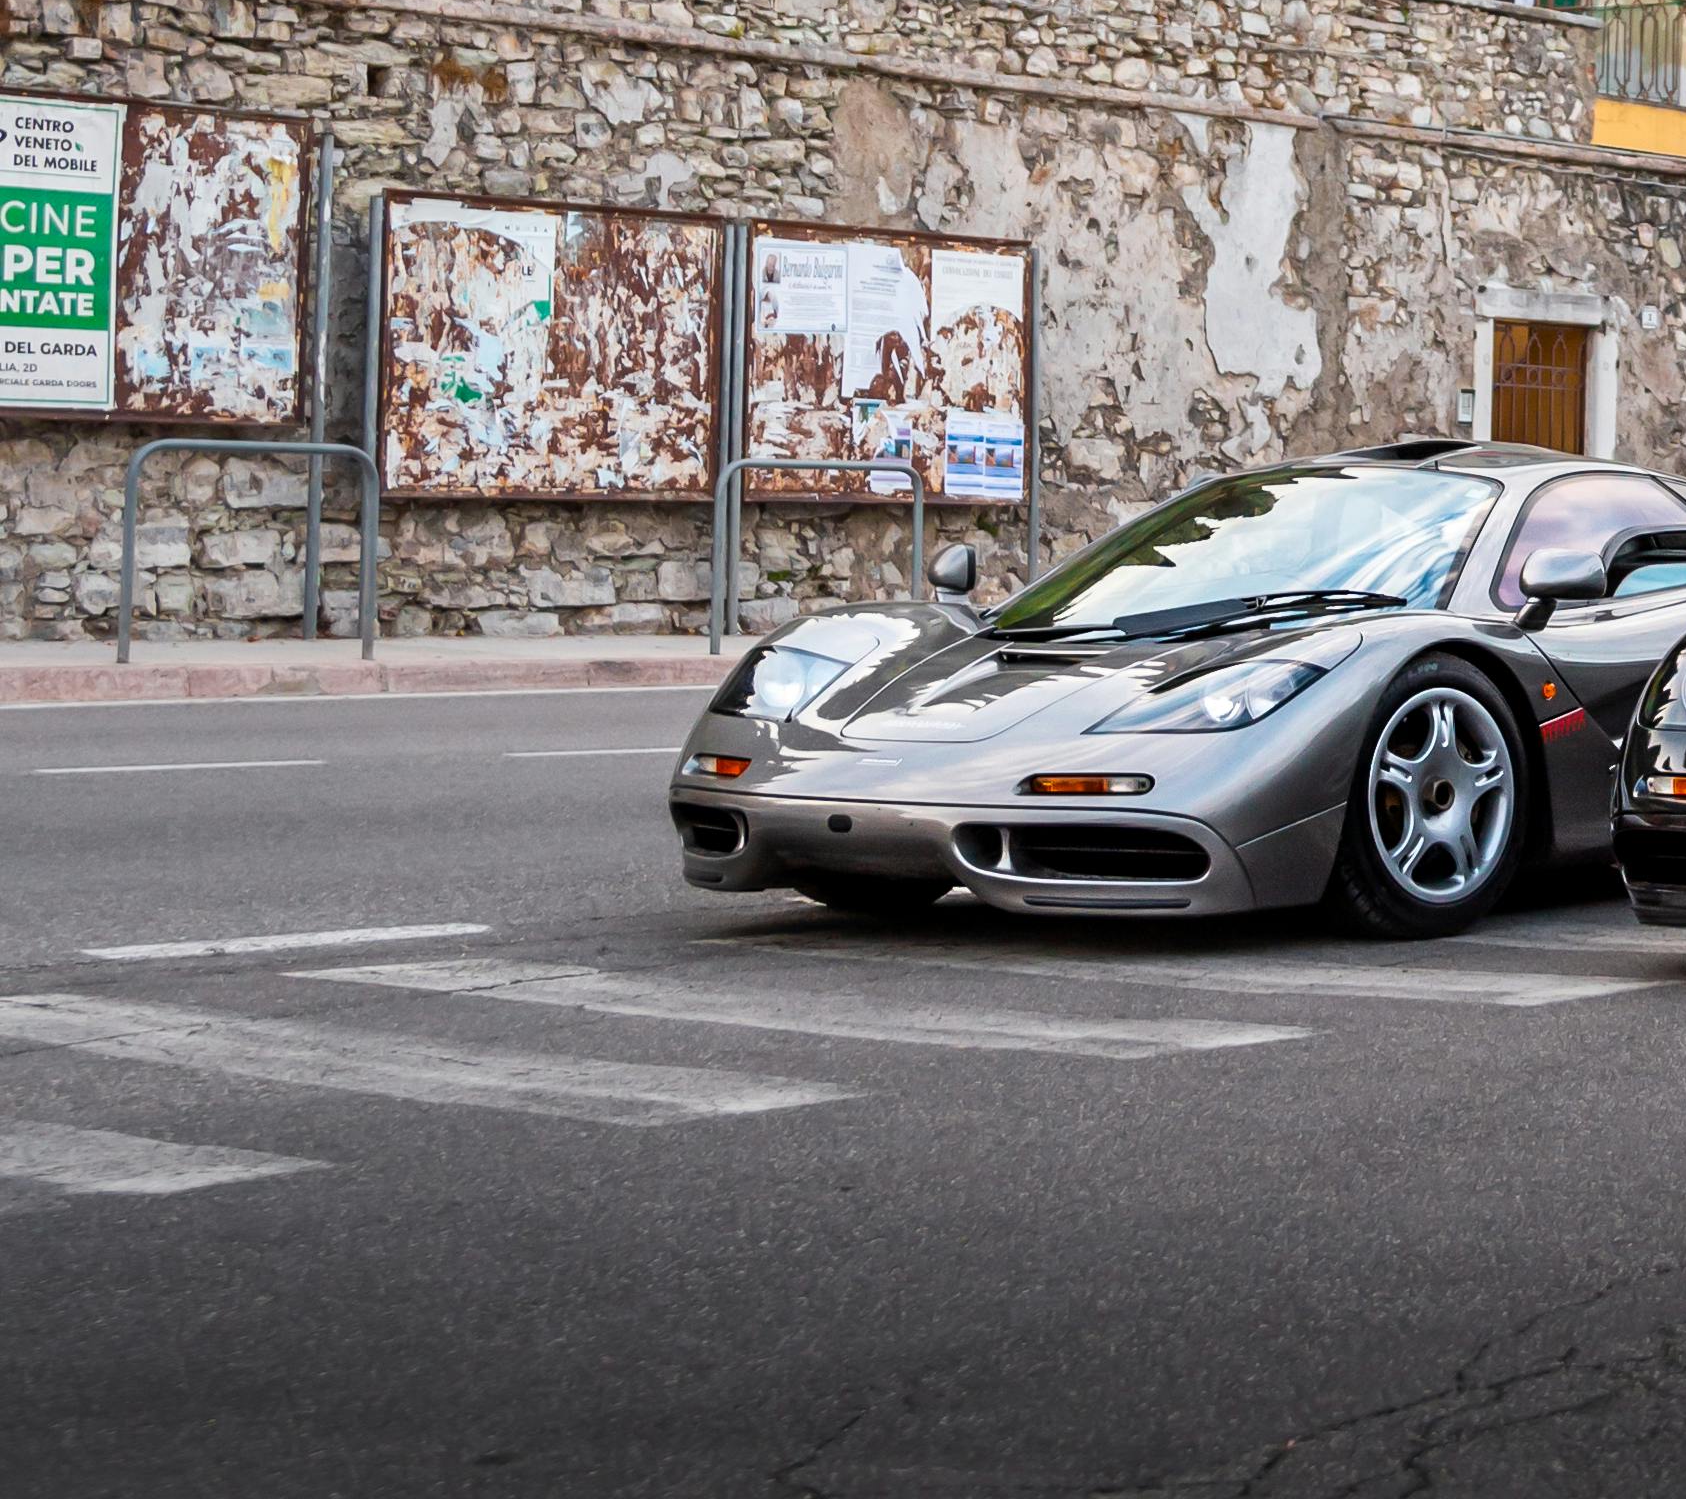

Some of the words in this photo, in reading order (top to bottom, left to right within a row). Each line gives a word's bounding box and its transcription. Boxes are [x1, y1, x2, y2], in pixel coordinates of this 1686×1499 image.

[15, 116, 74, 133] CENTRO
[14, 135, 72, 151] VENETO
[13, 154, 38, 168] DEL
[44, 156, 97, 172] MOBILE
[0, 200, 97, 238] CINE
[3, 244, 95, 286] PER
[0, 288, 95, 317] NTATE
[4, 341, 36, 354] DEL
[40, 342, 97, 357] GARDA
[23, 362, 38, 373] 2D
[32, 379, 64, 387] GARDA
